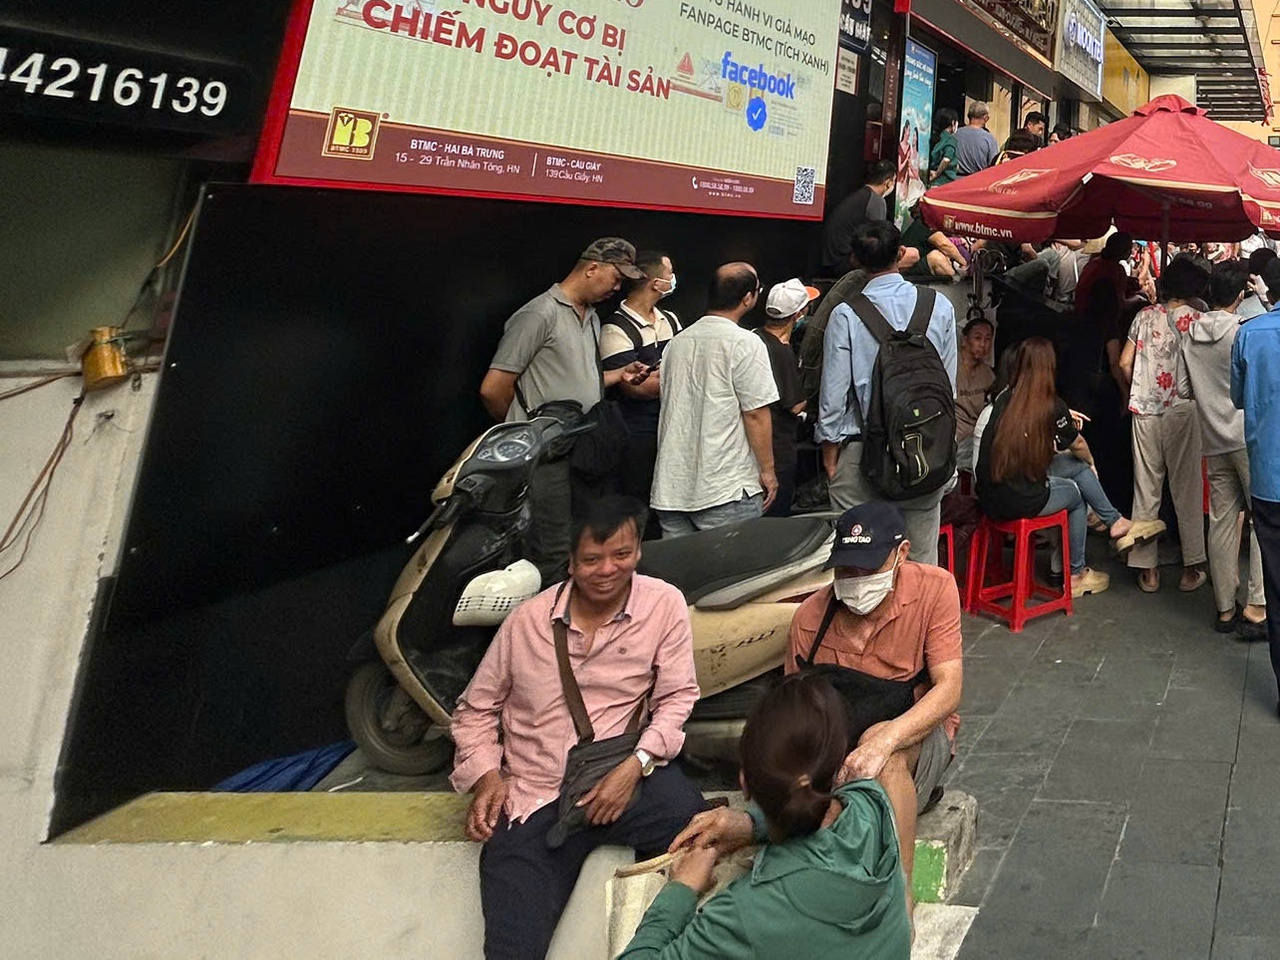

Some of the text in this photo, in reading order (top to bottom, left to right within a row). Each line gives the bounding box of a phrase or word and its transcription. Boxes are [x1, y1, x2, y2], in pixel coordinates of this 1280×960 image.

[558, 10, 597, 41] CƠ
[601, 23, 628, 58] BỊ
[680, 2, 740, 39] FANPAGE
[741, 27, 773, 52] BTMC
[774, 40, 800, 63] (TÍCH
[801, 51, 830, 77] XANH)
[762, 12, 773, 29] VI
[774, 18, 793, 36] GIẢ
[794, 28, 816, 48] MẠO
[493, 32, 579, 79] ĐOẠT
[584, 55, 623, 88] TÀI
[626, 65, 672, 100] SẢN
[721, 50, 796, 101] facebook
[395, 151, 408, 163] 15
[419, 153, 433, 166] 29
[507, 164, 521, 174] HN
[410, 139, 438, 153] BTMC
[444, 143, 461, 156] HAI
[461, 143, 475, 157] BÀ
[475, 147, 505, 160] TRƯNG
[546, 156, 567, 168] BTMC
[592, 174, 603, 184] HN
[955, 220, 1013, 238] www.btmc.vn
